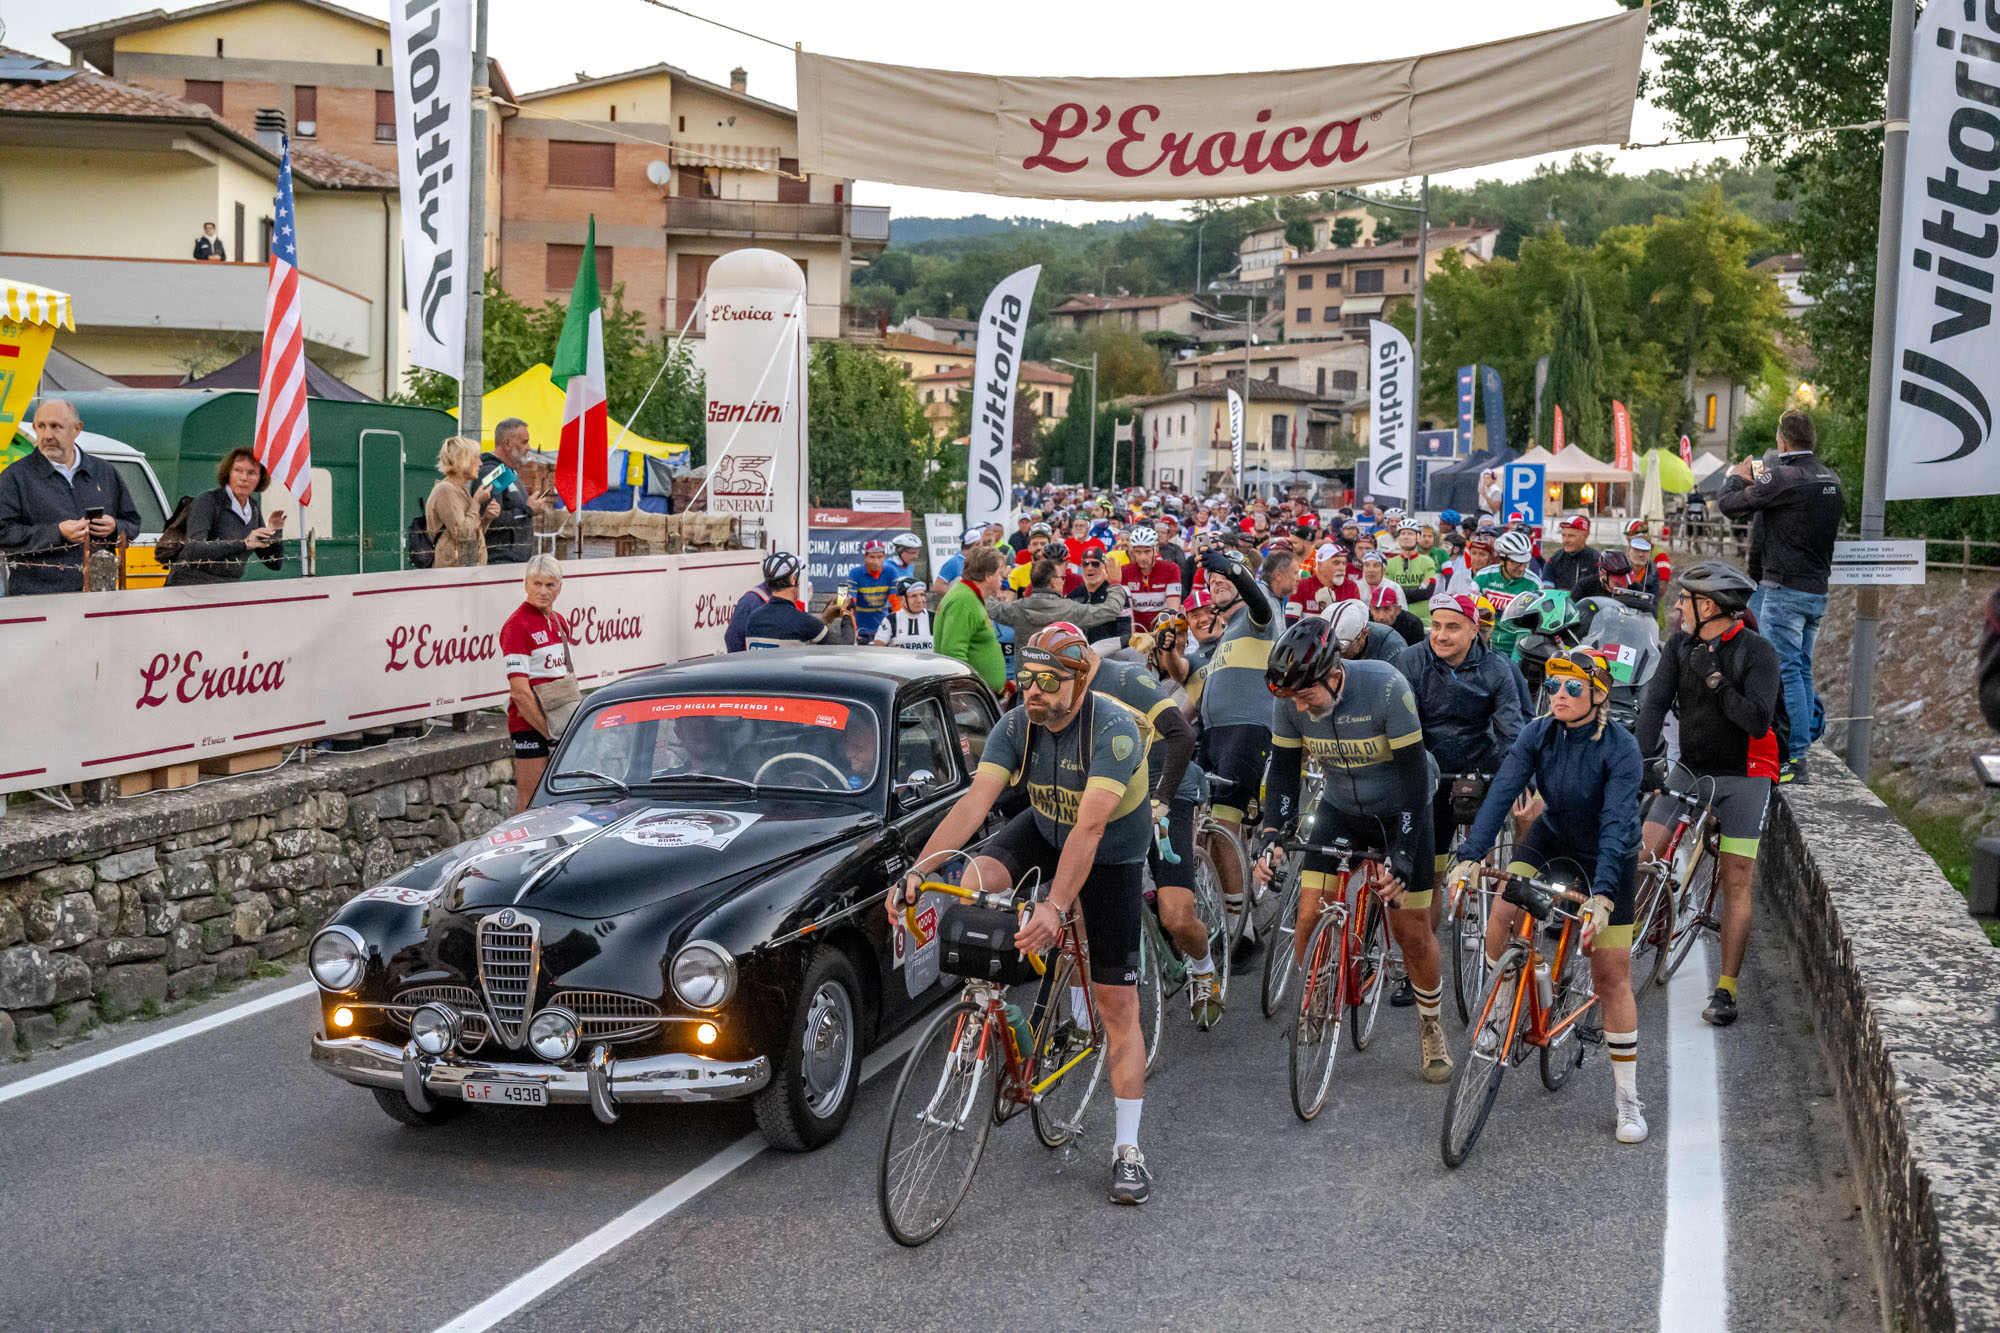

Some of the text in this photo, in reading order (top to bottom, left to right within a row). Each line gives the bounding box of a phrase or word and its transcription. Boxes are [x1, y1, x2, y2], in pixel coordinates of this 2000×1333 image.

[1022, 102, 1369, 178] L'Eroica
[711, 304, 774, 322] L'Eroica
[983, 294, 1023, 458] vittoria
[707, 400, 790, 423] Santini
[1511, 467, 1538, 501] P
[713, 498, 774, 513] GENERALI
[809, 540, 831, 555] CINA
[839, 541, 860, 555] BIKE
[695, 593, 736, 630] L'Eroi
[566, 606, 644, 647] L'Eroica
[384, 623, 497, 673] L'Eroica
[1021, 649, 1051, 661] alvento
[1623, 650, 1630, 661] 2
[543, 653, 567, 670] Eroi
[136, 650, 286, 710] L'Eroica
[719, 703, 769, 711] FRIENDS
[774, 704, 785, 712] 14
[1309, 740, 1378, 756] GUARDIA DI
[1029, 785, 1079, 808] UARDIA
[504, 1086, 542, 1102] 4938
